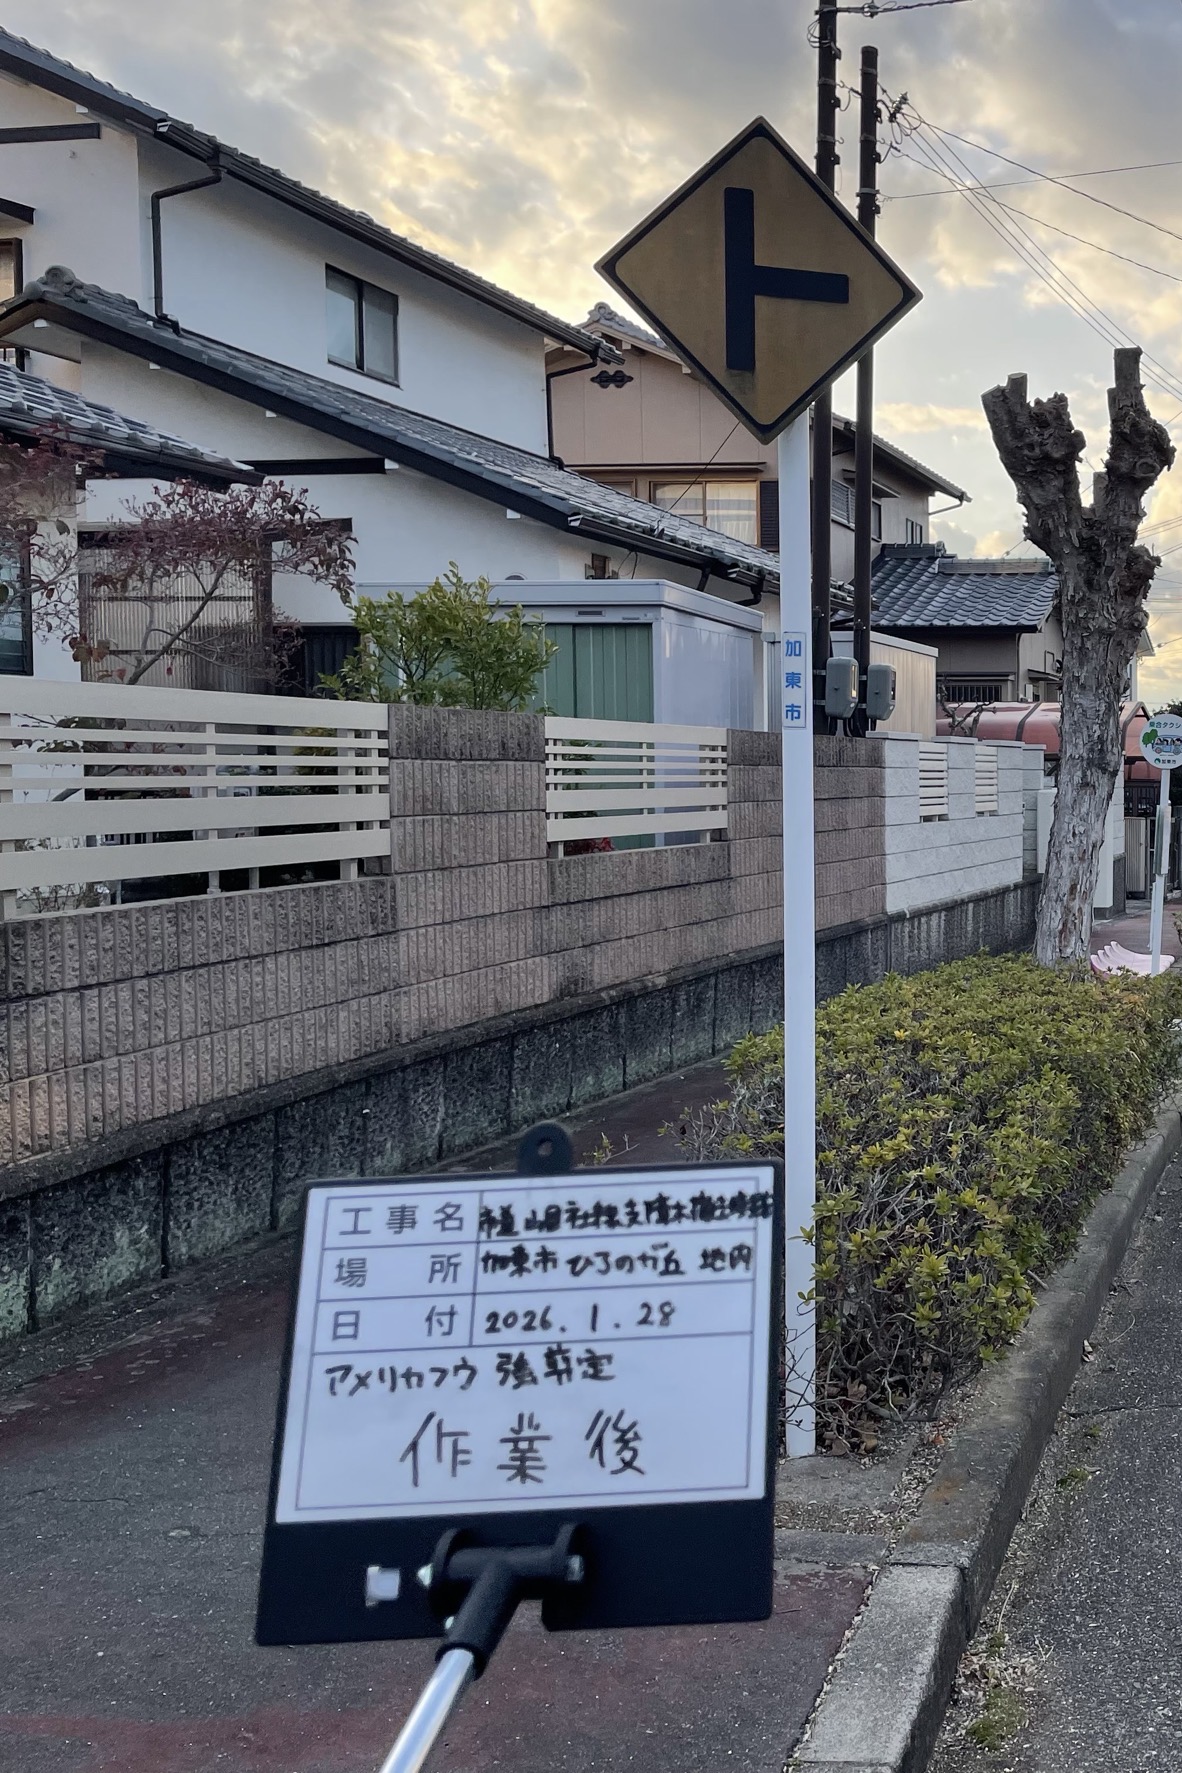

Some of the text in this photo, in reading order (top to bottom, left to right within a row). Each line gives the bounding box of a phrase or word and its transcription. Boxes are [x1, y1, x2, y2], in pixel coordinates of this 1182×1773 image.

[785, 639, 802, 721] 加東市
[340, 1201, 465, 1236] 工事名
[335, 1253, 462, 1288] 場所
[481, 1247, 558, 1278] 加東市
[331, 1305, 459, 1341] 日付
[399, 1409, 645, 1488] 作業後
